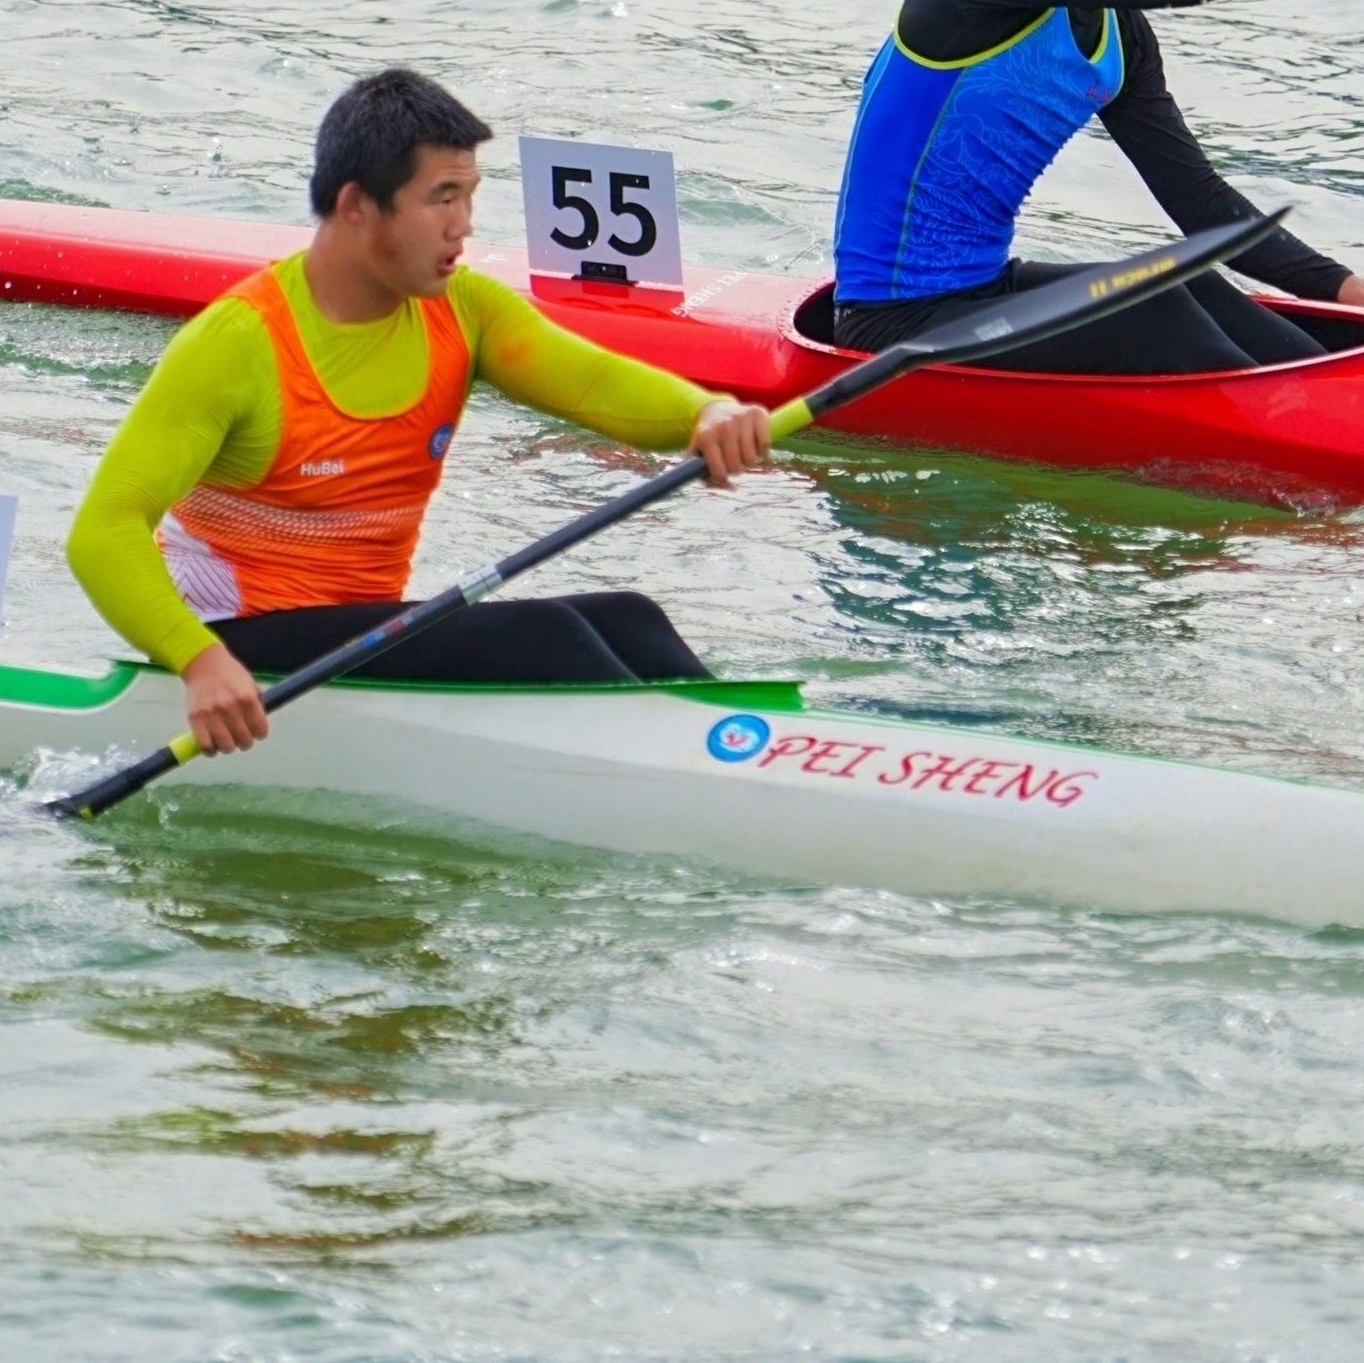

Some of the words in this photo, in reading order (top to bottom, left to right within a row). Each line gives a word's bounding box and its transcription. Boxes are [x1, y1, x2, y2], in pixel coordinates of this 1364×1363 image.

[550, 165, 657, 257] 55
[299, 459, 345, 477] HuBei
[758, 736, 885, 779] PEI
[878, 750, 1099, 808] SHENG
